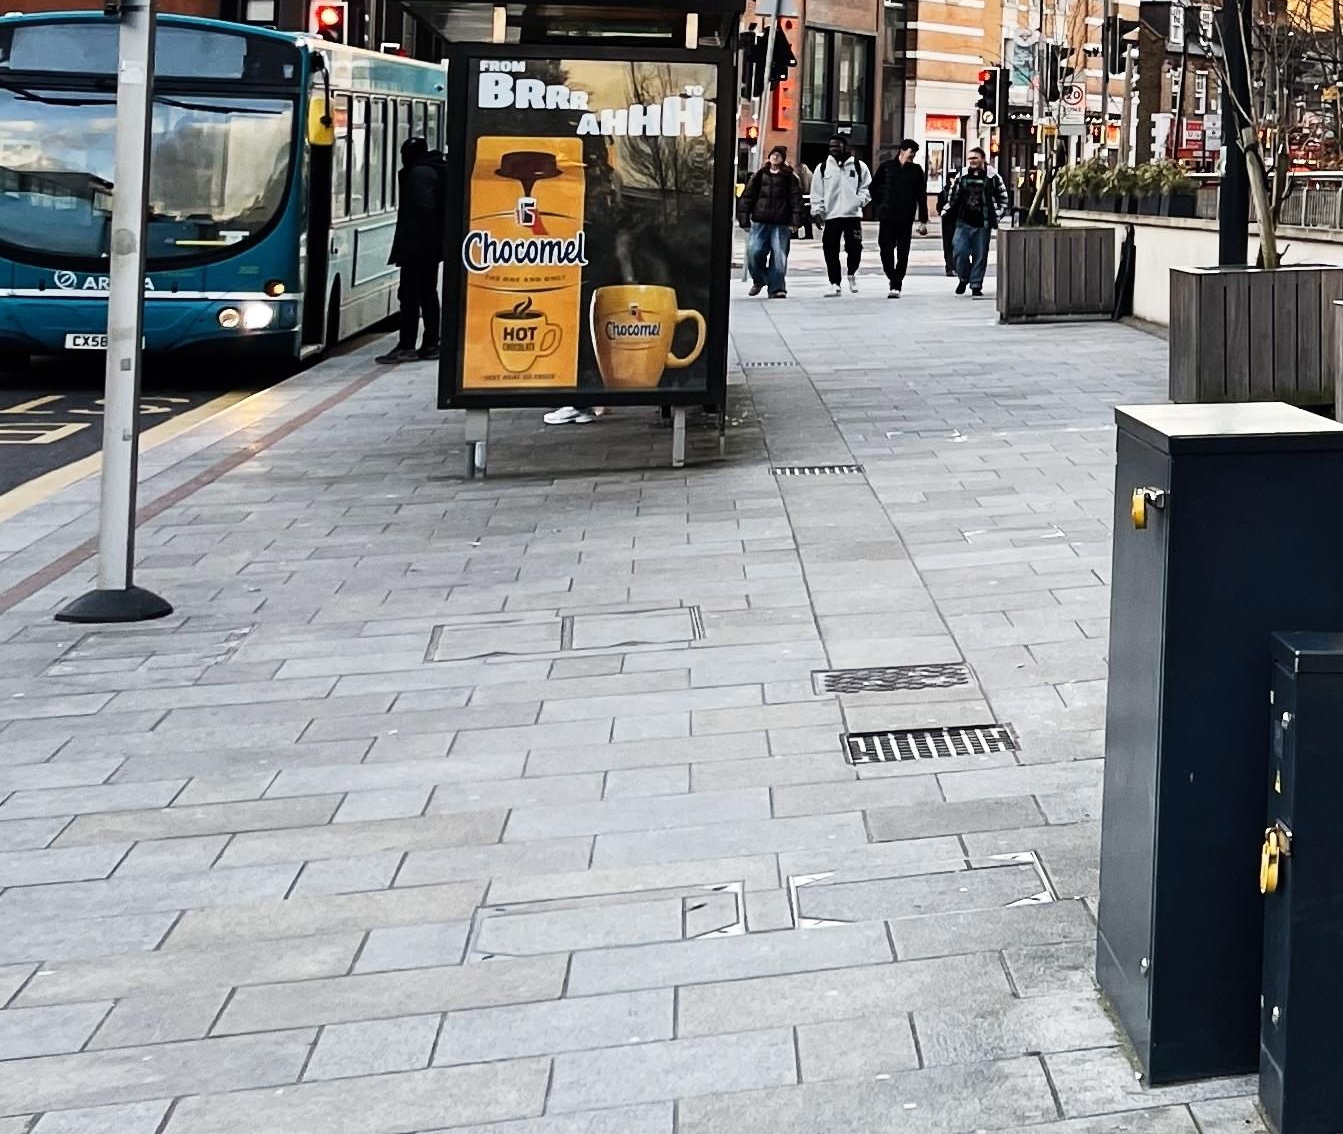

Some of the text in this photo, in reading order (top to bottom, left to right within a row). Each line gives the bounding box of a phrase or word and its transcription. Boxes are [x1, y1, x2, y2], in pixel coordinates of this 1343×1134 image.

[479, 60, 526, 72] FROM
[478, 72, 589, 110] BRRR
[684, 85, 705, 96] TO
[576, 95, 704, 137] AHHH
[463, 231, 588, 273] Chocomel
[83, 277, 154, 289] ARA
[503, 327, 538, 341] HOT
[605, 321, 661, 340] Chocomel
